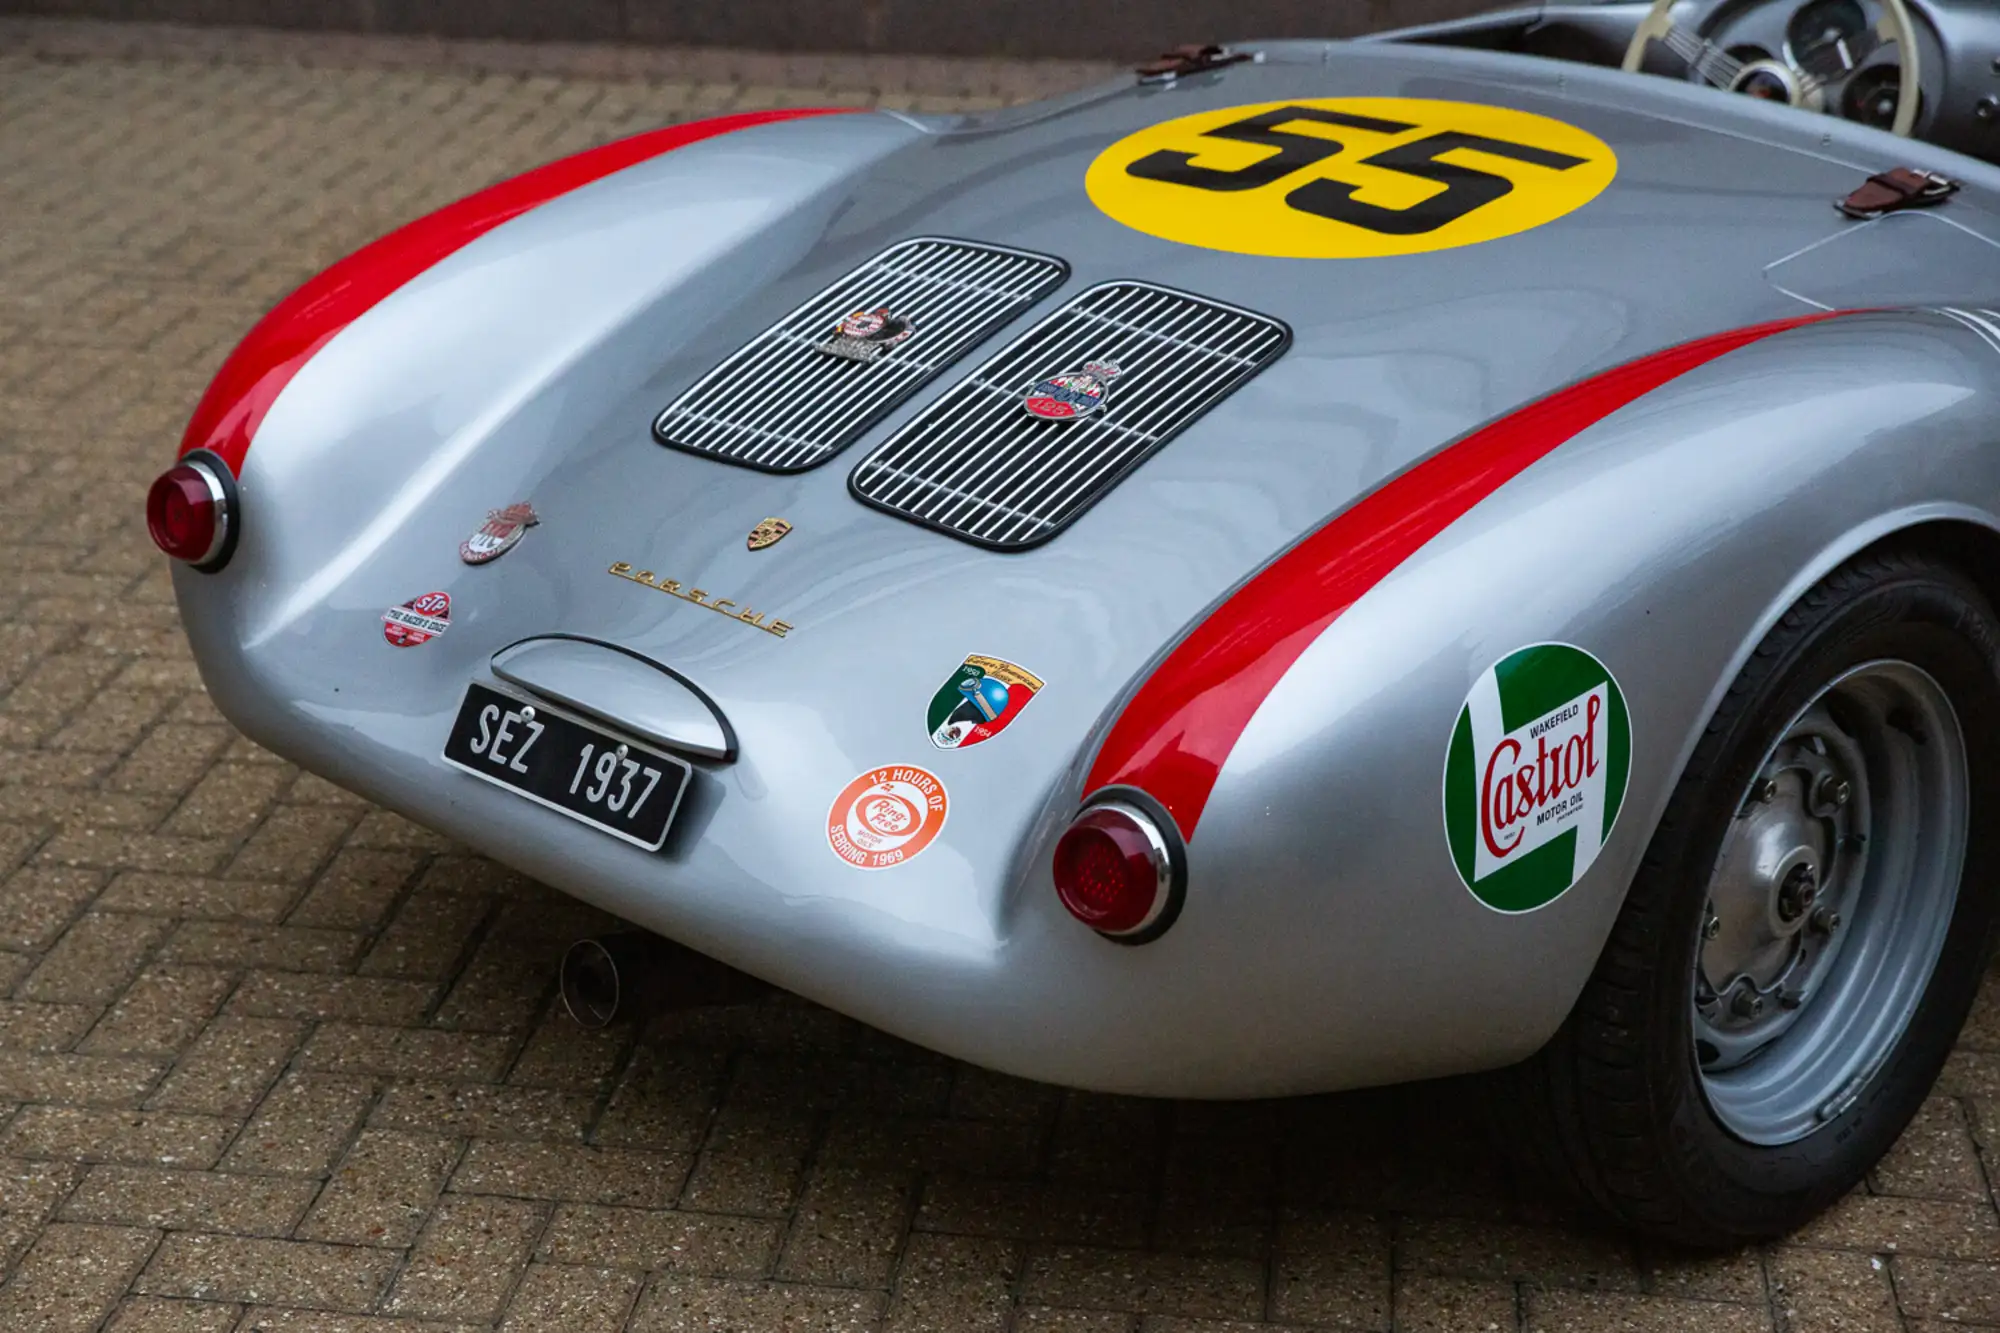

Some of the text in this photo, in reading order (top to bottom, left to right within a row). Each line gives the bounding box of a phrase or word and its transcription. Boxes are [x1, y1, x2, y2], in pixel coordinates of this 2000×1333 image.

[1126, 105, 1592, 235] 55
[416, 594, 447, 611] STP
[608, 561, 794, 638] PORSCHE
[1530, 704, 1578, 739] WAKEFIELD
[470, 704, 662, 819] SEZ 1937
[1481, 694, 1601, 858] Castrol
[870, 768, 943, 812] 12 HOURS OF
[1537, 791, 1584, 826] MOTOR OIL
[856, 829, 883, 844] MOTOR
[869, 813, 900, 832] Free
[830, 823, 904, 866] SEBRING 1969
